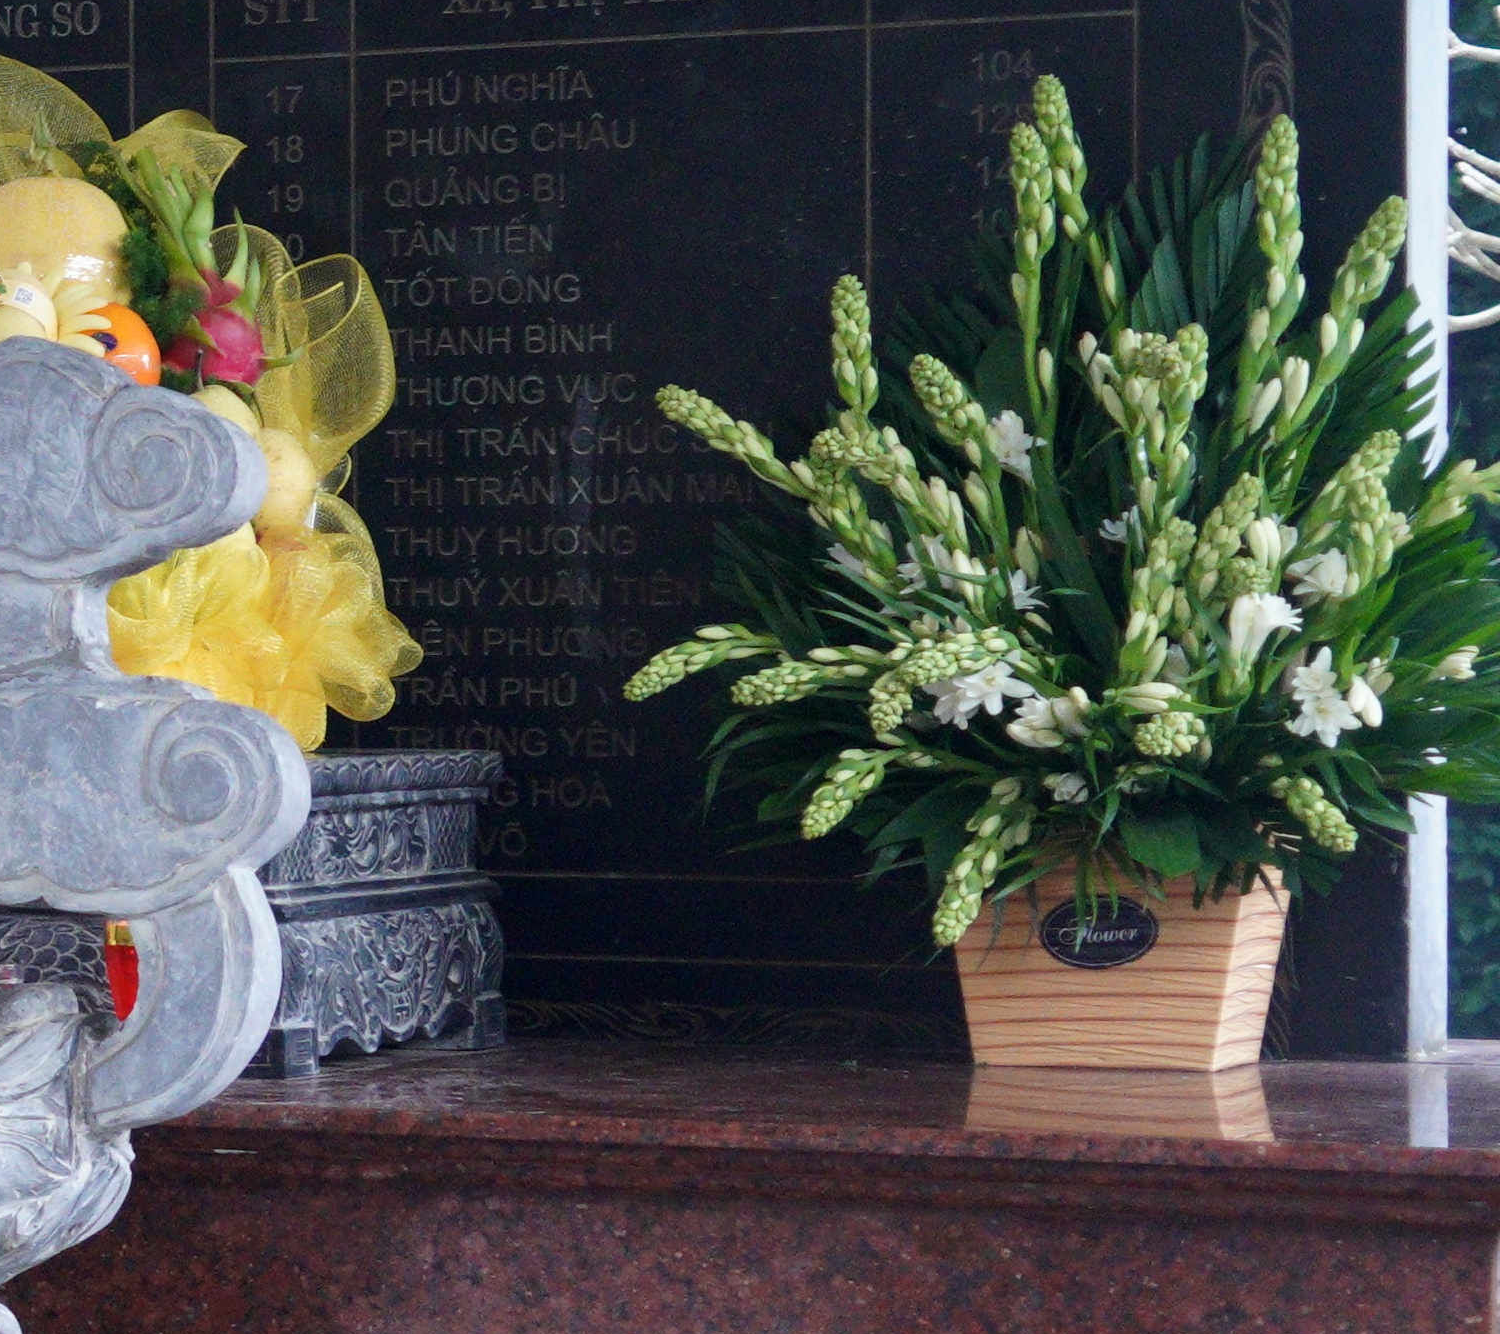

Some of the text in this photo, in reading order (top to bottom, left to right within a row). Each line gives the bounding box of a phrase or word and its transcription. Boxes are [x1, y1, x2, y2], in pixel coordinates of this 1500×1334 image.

[266, 84, 304, 115] 17
[385, 69, 462, 108] PHÚ
[474, 64, 595, 104] NGHĨA
[266, 134, 304, 165] 18
[530, 112, 638, 153] CHÂU
[266, 183, 305, 213] 19
[385, 166, 521, 208] QUẢNG
[531, 173, 567, 208] BỊ
[385, 220, 459, 259] TÂN
[469, 212, 554, 255] TIẾN
[384, 267, 458, 307] TỐT
[389, 317, 614, 357] THANH BÌNH
[385, 427, 444, 466] THỊ
[457, 416, 559, 458] TRẤN
[385, 476, 444, 514] THỊ
[456, 465, 557, 506] TRẤN
[568, 465, 673, 505] XUÂN
[497, 524, 637, 557] HƯƠNG
[497, 569, 602, 607] XUÂN
[500, 671, 577, 707] PHÚ
[560, 719, 637, 757] YÊN
